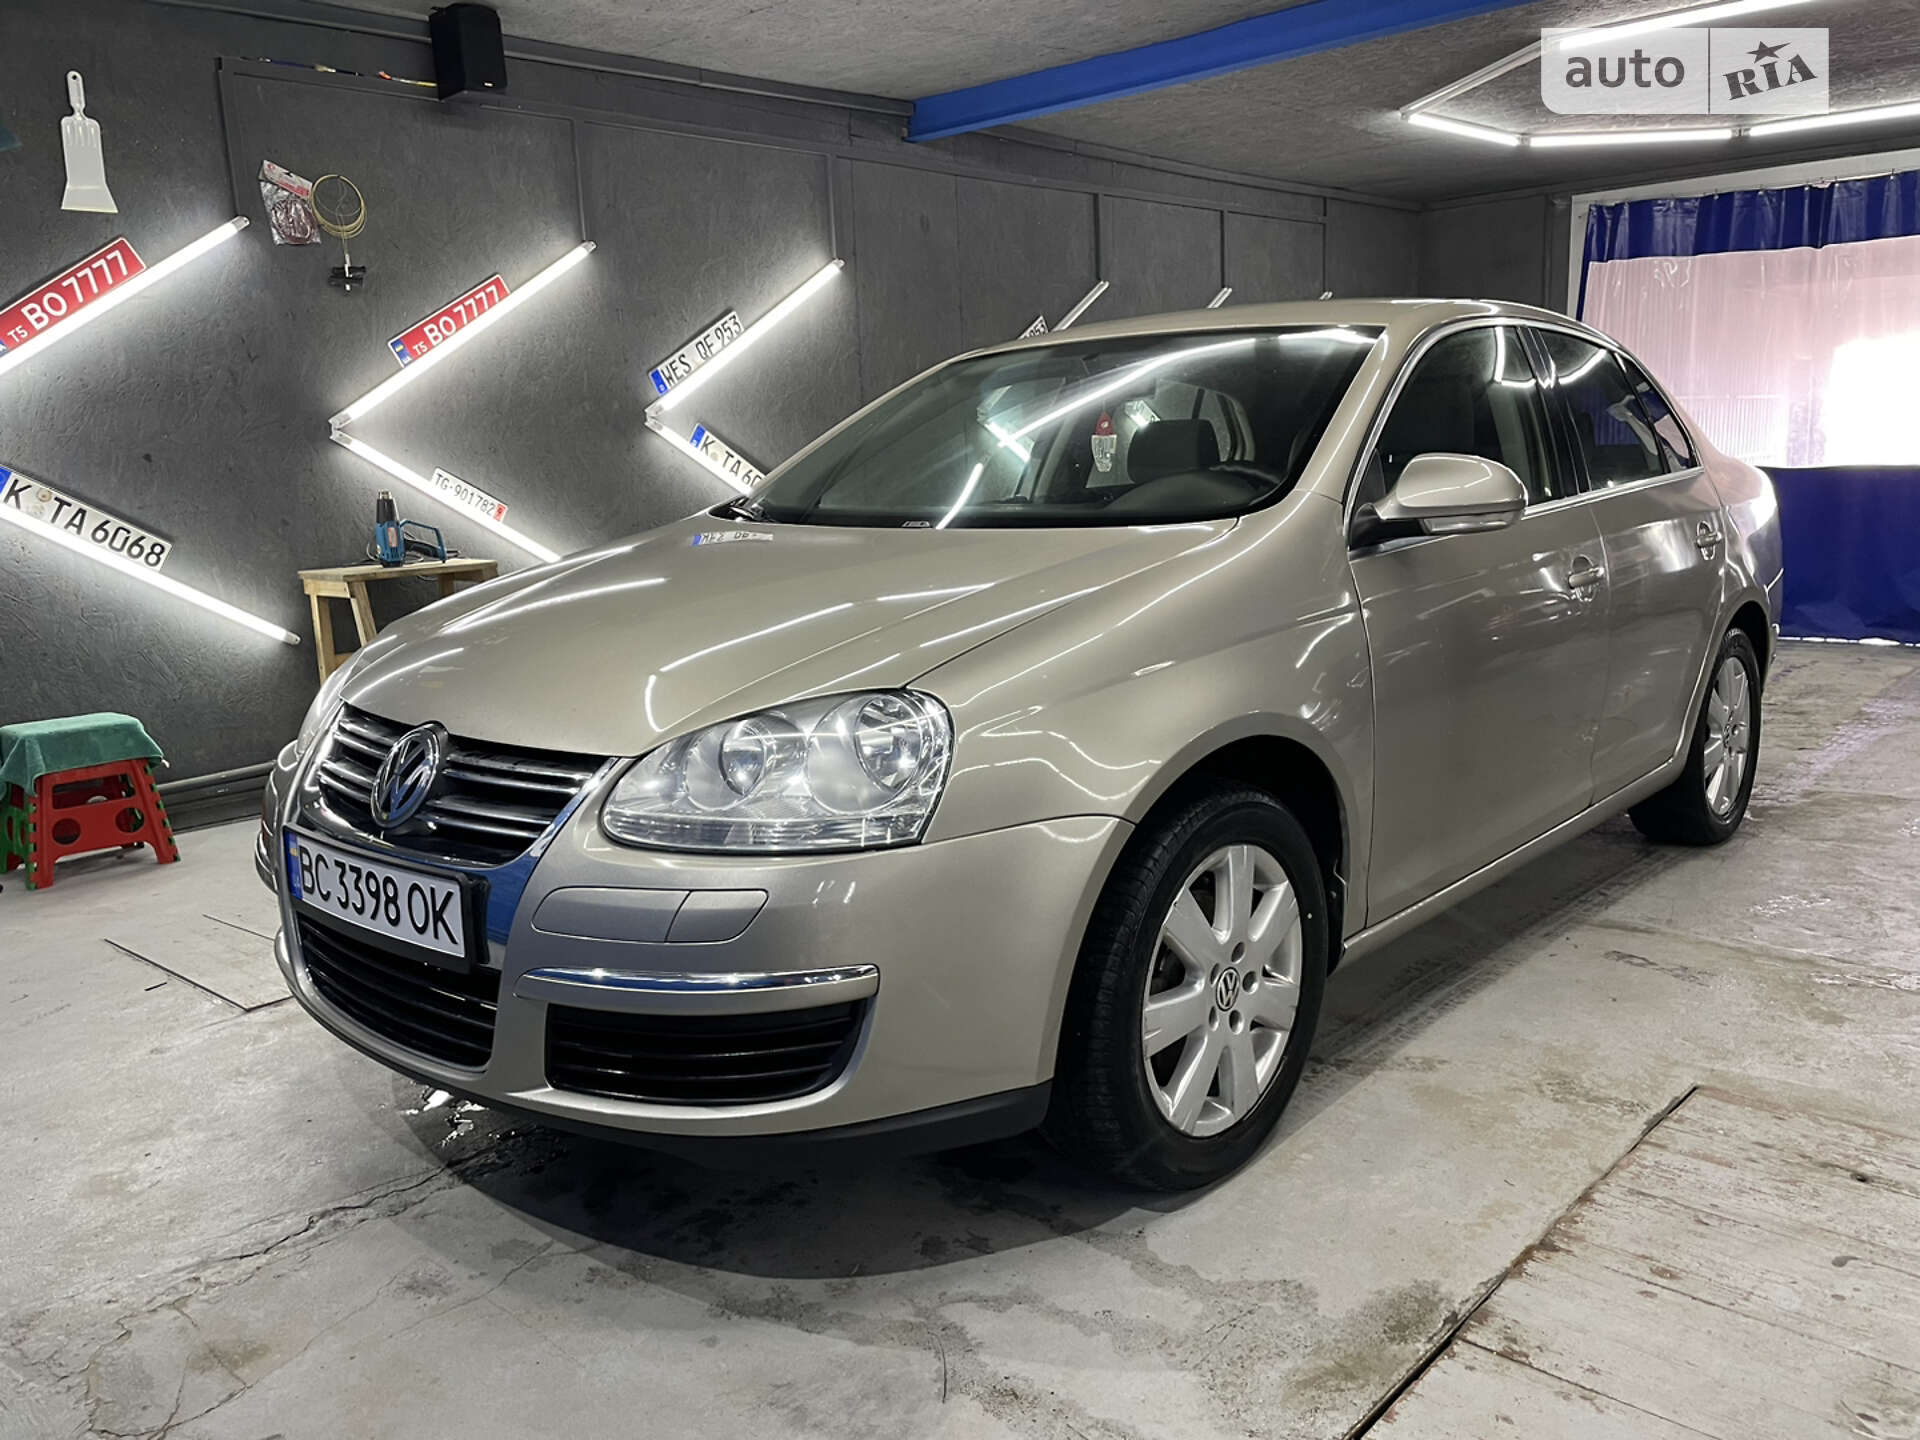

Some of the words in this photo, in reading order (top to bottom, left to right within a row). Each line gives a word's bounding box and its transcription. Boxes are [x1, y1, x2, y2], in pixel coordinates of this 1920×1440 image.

[7, 325, 28, 343] TS
[21, 292, 68, 331] BO
[62, 250, 129, 304] 7777
[412, 341, 428, 355] TS
[423, 316, 457, 346] BO
[452, 285, 500, 325] 7777
[660, 354, 692, 388] WES
[701, 435, 715, 457] K
[722, 450, 741, 477] TA
[4, 478, 32, 510] K
[50, 496, 88, 536] TA
[91, 519, 166, 568] 6068
[298, 846, 332, 902] BC
[334, 859, 401, 927] 3398
[407, 882, 458, 945] OK
